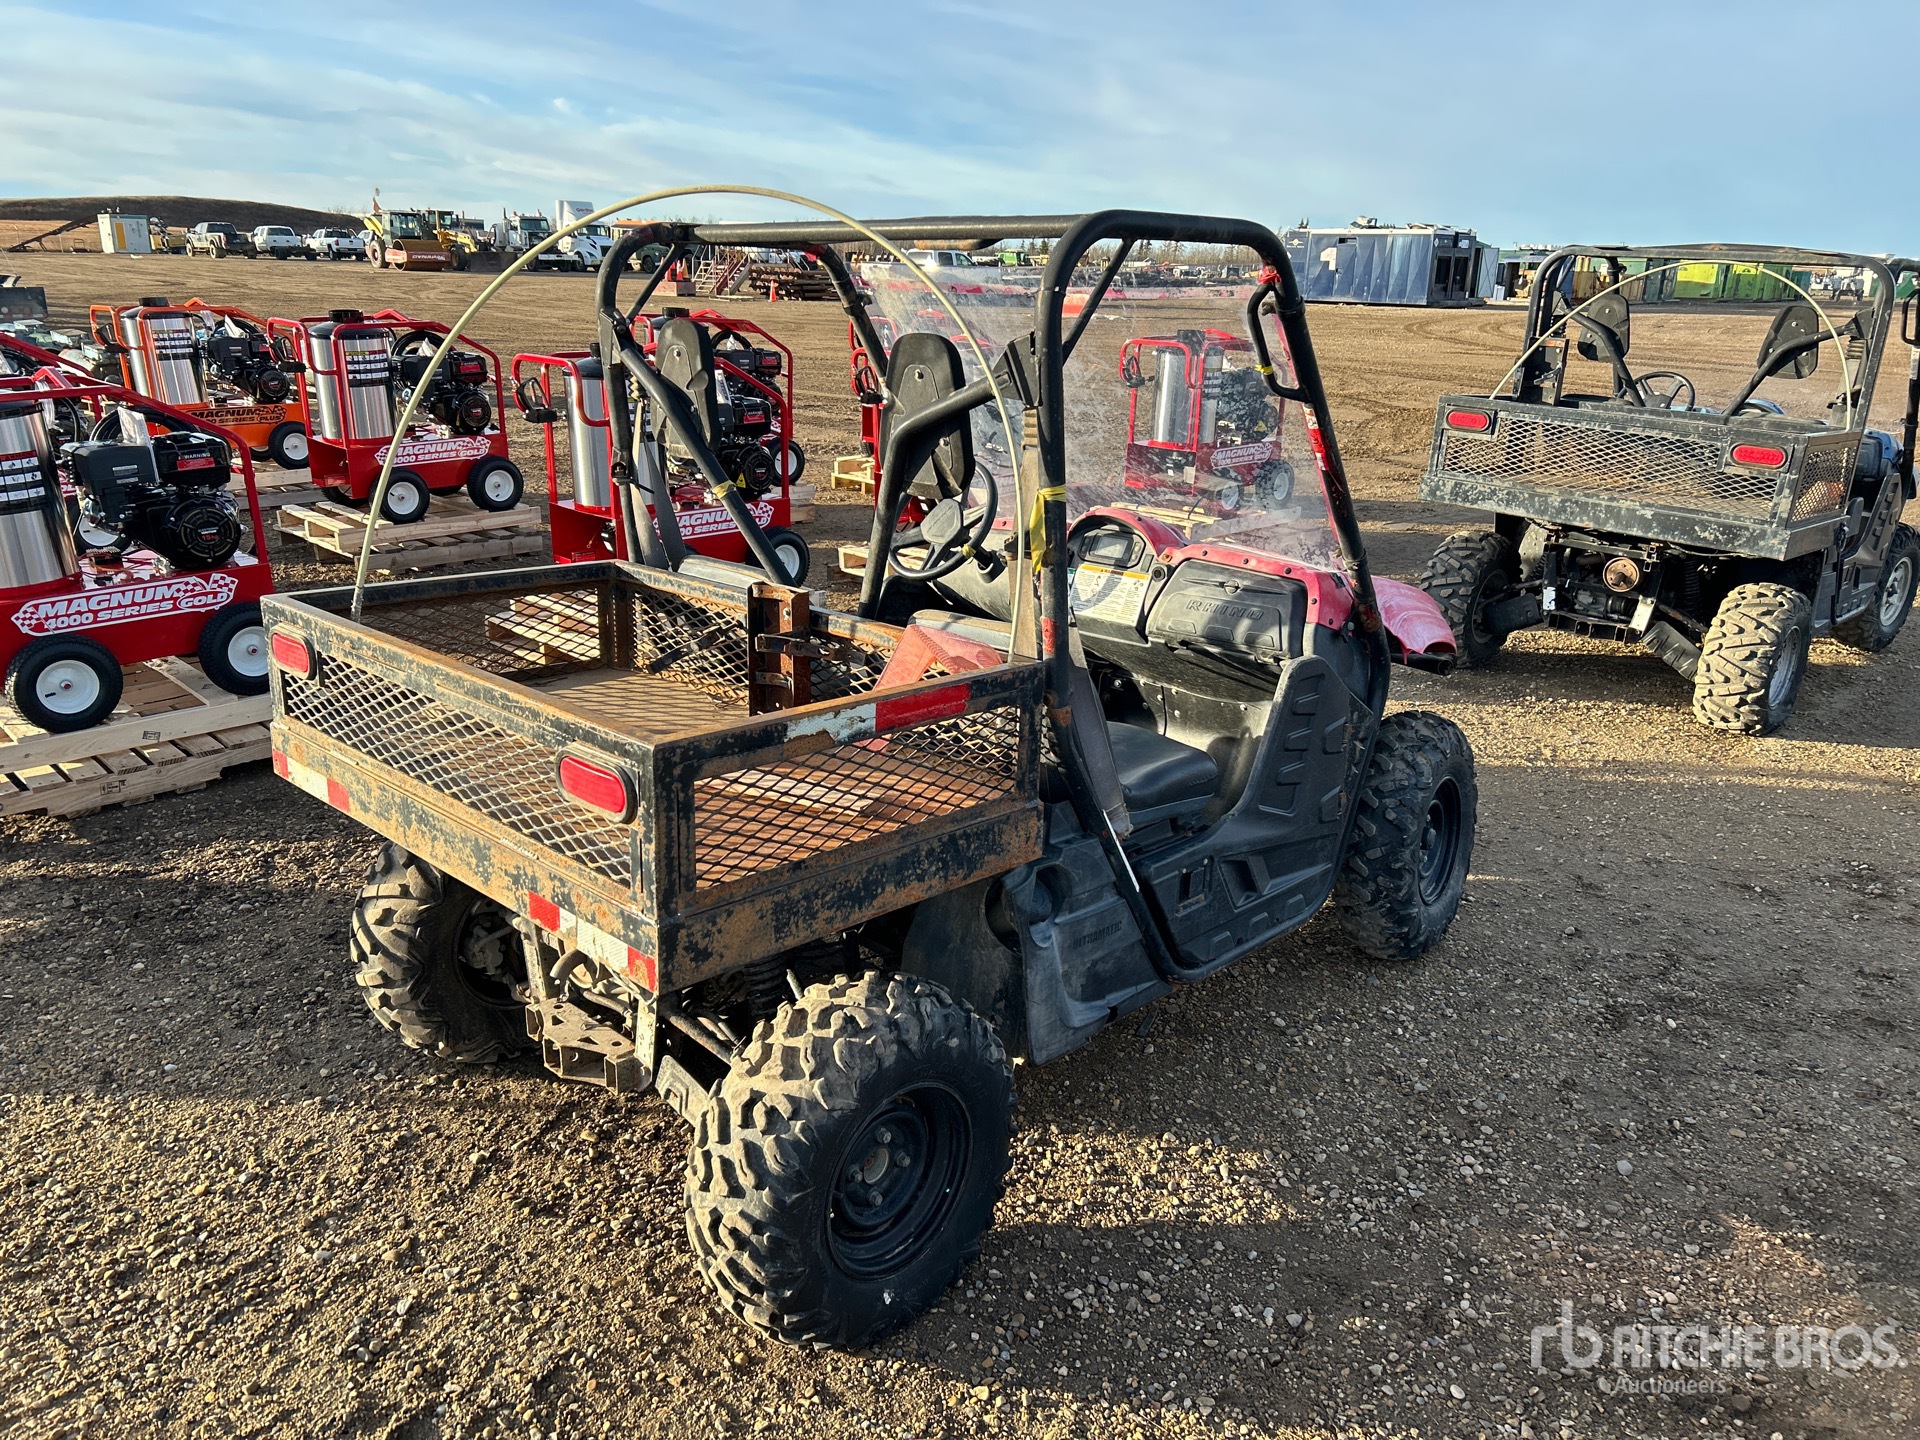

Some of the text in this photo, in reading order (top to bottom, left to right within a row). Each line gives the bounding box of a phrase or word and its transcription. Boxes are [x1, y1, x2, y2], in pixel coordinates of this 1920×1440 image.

[191, 408, 259, 419] MAGNUM
[183, 452, 211, 460] WARNING
[417, 452, 457, 461] SERIES
[1217, 446, 1257, 459] MAGNUM
[675, 510, 735, 527] AGNU
[680, 521, 737, 536] 00 SERIES
[37, 583, 183, 619] MAGNUM
[179, 592, 228, 608] GOLD
[44, 600, 173, 630] 4000 SERIES
[1185, 599, 1265, 620] RHINO
